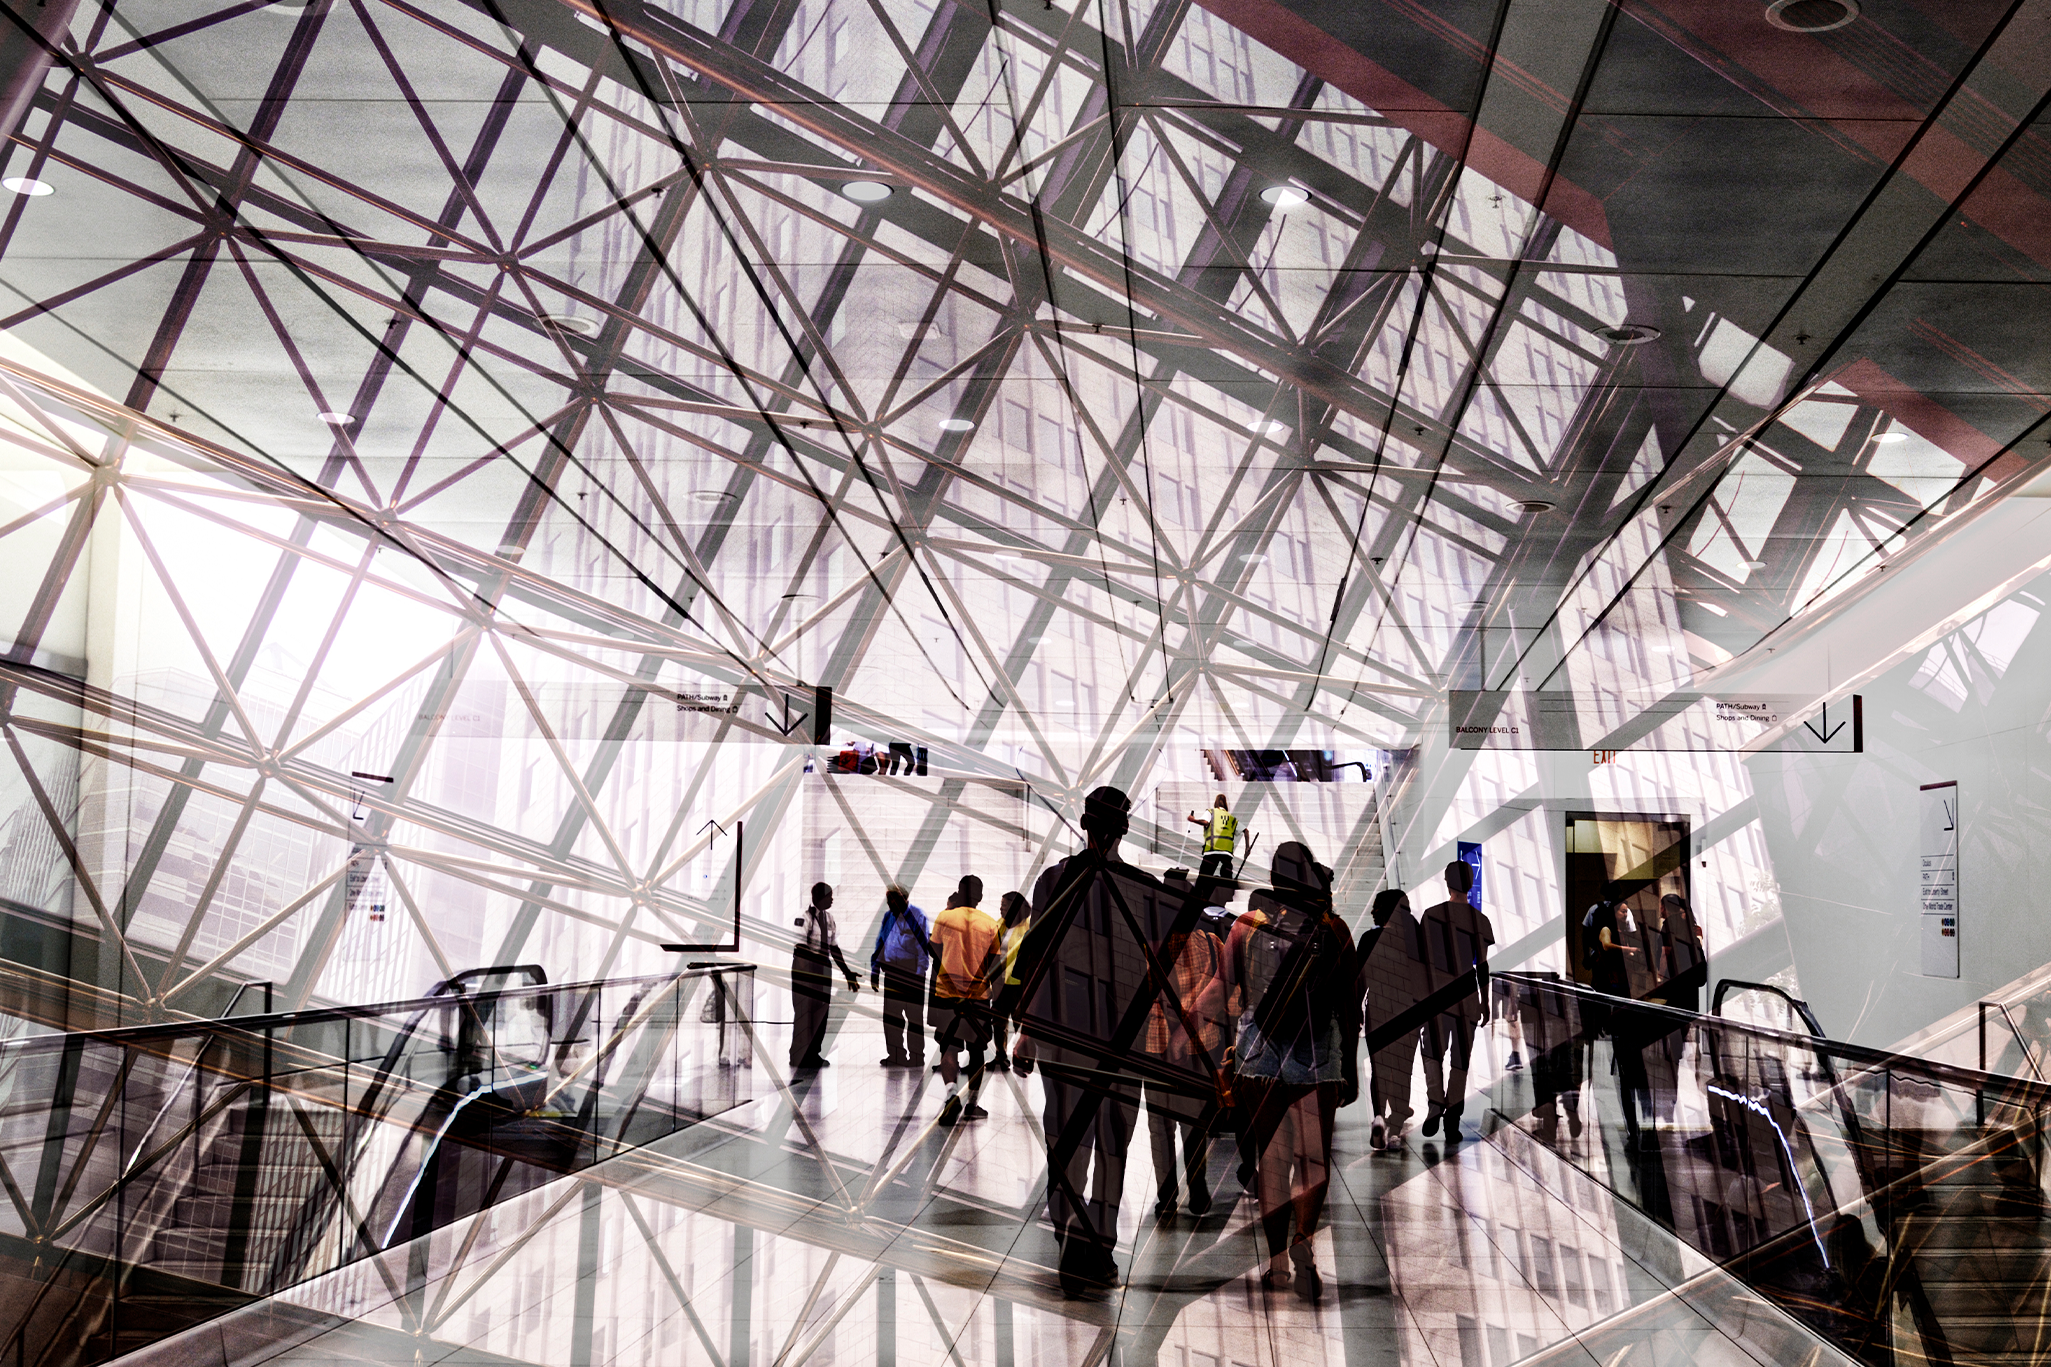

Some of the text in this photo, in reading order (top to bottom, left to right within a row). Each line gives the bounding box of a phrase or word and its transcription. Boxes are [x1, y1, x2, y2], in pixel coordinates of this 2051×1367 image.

[676, 694, 721, 702] PATH/Subway
[710, 706, 730, 714] Dining
[1716, 702, 1760, 710] PATH/Subway
[1750, 714, 1770, 722] Dining
[1594, 750, 1616, 764] EXIT
